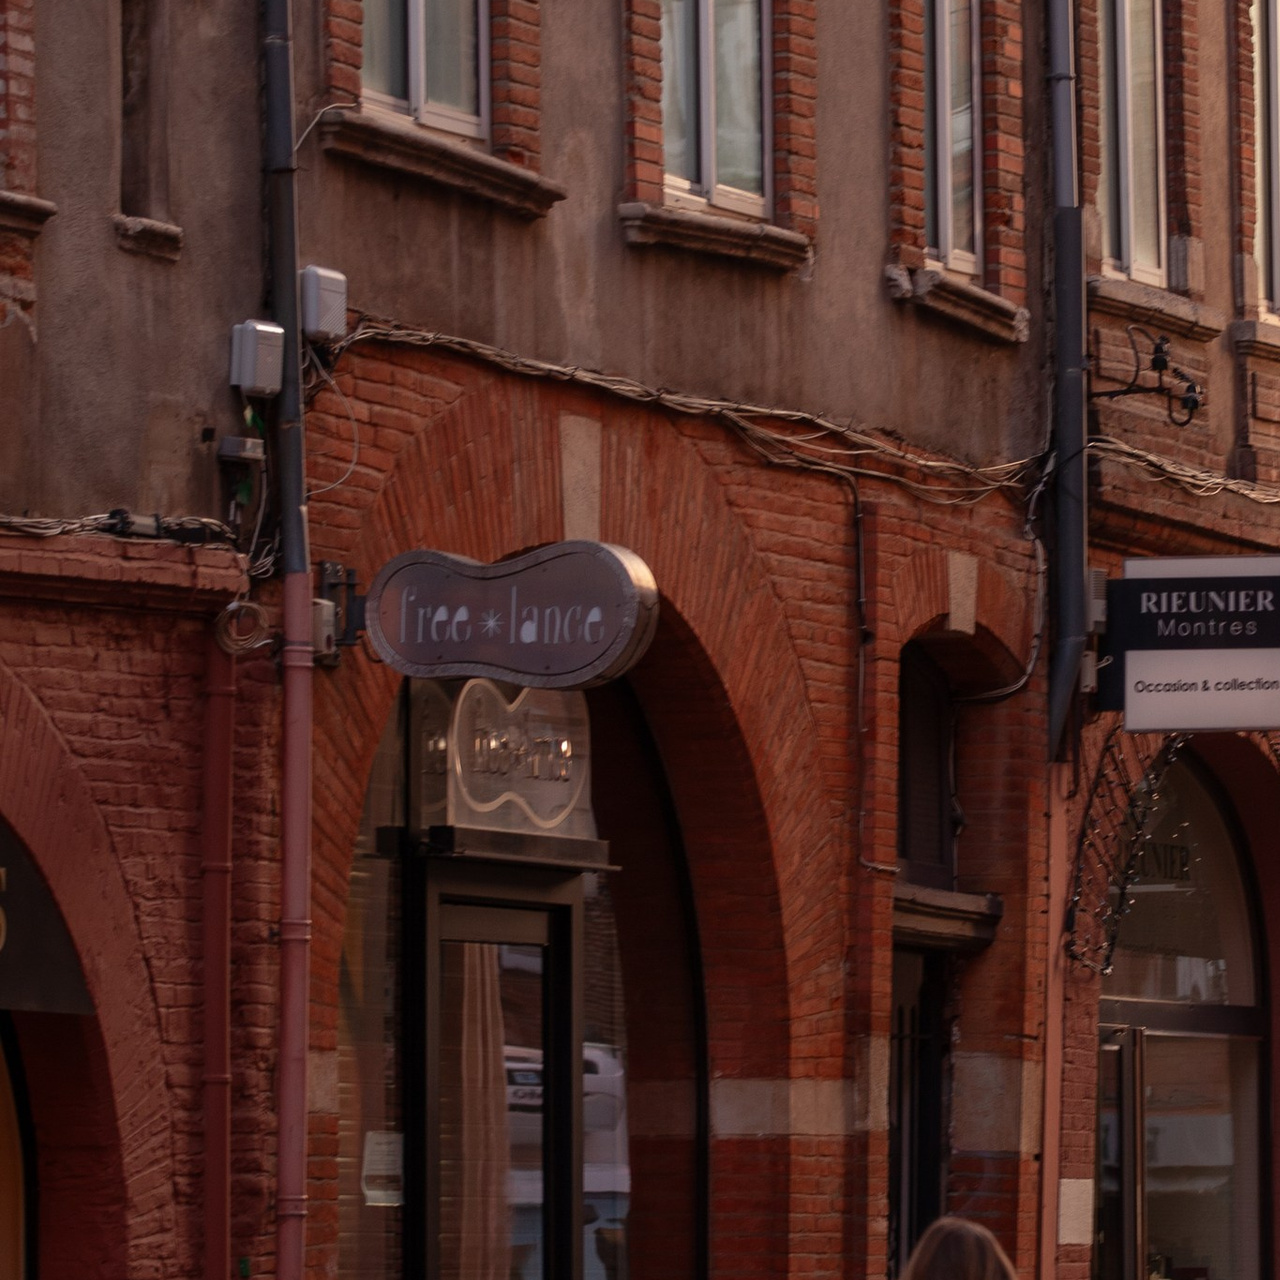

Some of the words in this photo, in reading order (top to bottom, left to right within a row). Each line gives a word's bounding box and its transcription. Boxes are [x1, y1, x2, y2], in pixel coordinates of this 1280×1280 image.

[1140, 589, 1276, 614] RIEUNIER
[399, 585, 474, 644] free
[509, 585, 605, 645] lance
[1157, 617, 1258, 638] Montres
[1134, 679, 1199, 693] Occasion
[1201, 679, 1210, 693] &
[1213, 677, 1280, 693] collection
